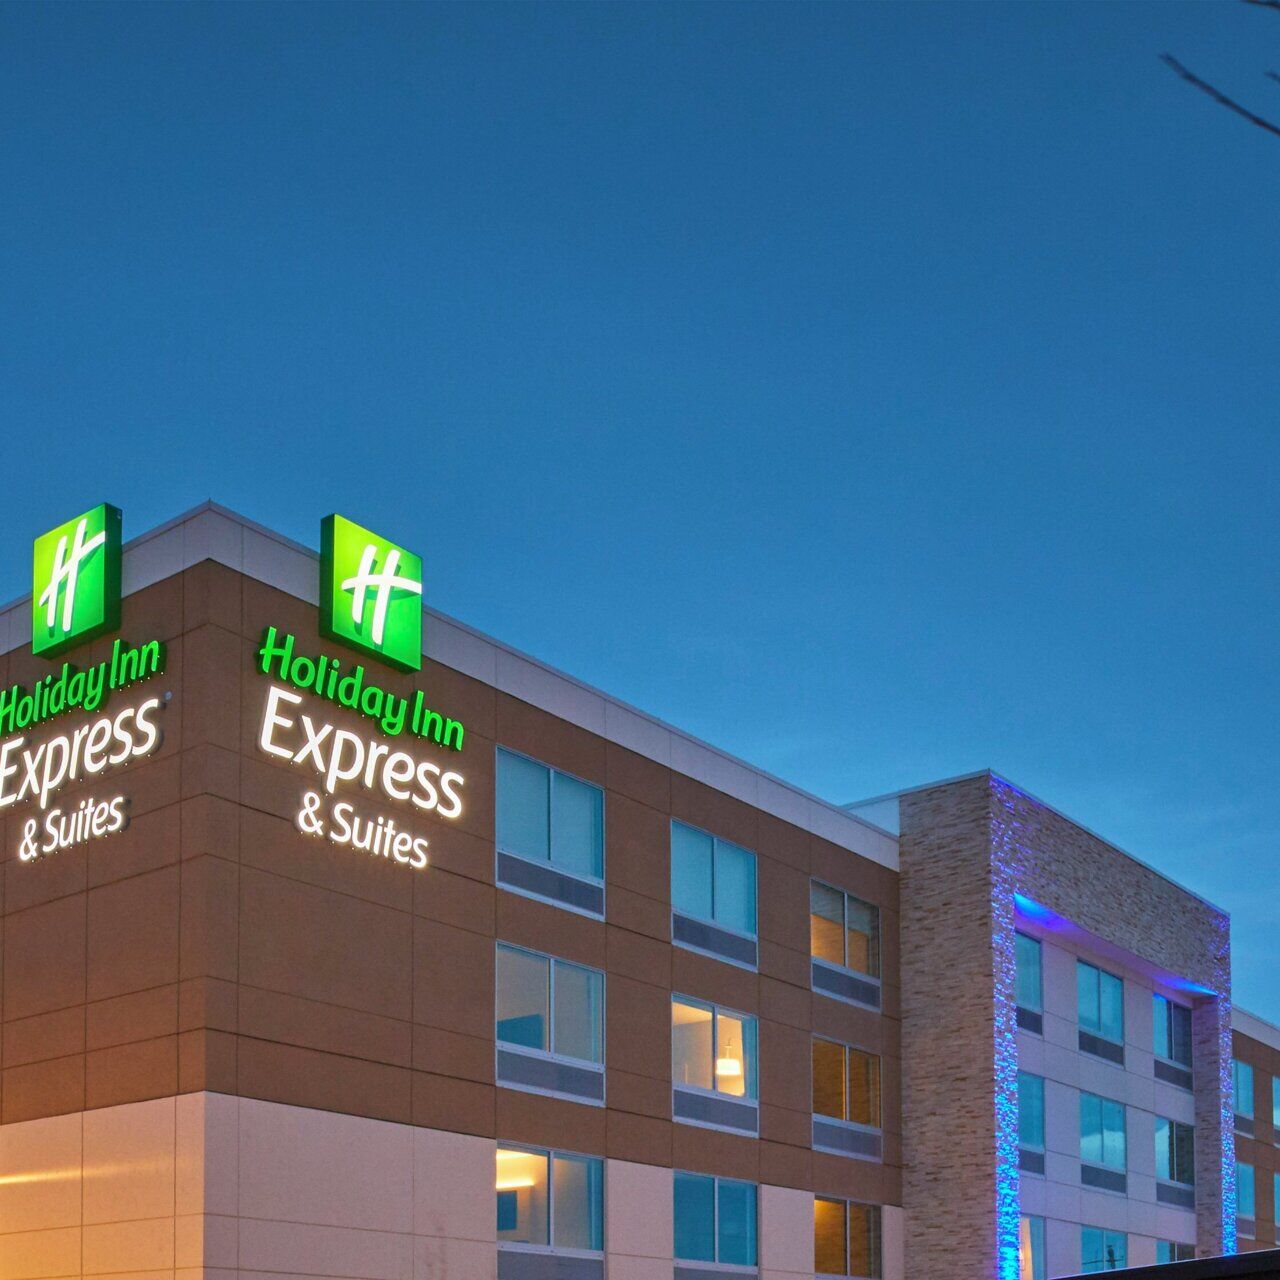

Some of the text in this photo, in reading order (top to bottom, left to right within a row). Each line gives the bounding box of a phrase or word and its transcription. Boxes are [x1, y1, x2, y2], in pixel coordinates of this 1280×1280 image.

[110, 639, 160, 689] Inn
[259, 626, 465, 751] Holiday Inn
[260, 685, 465, 818] Express
[19, 796, 124, 861] & Suites
[297, 791, 429, 869] & Suites
